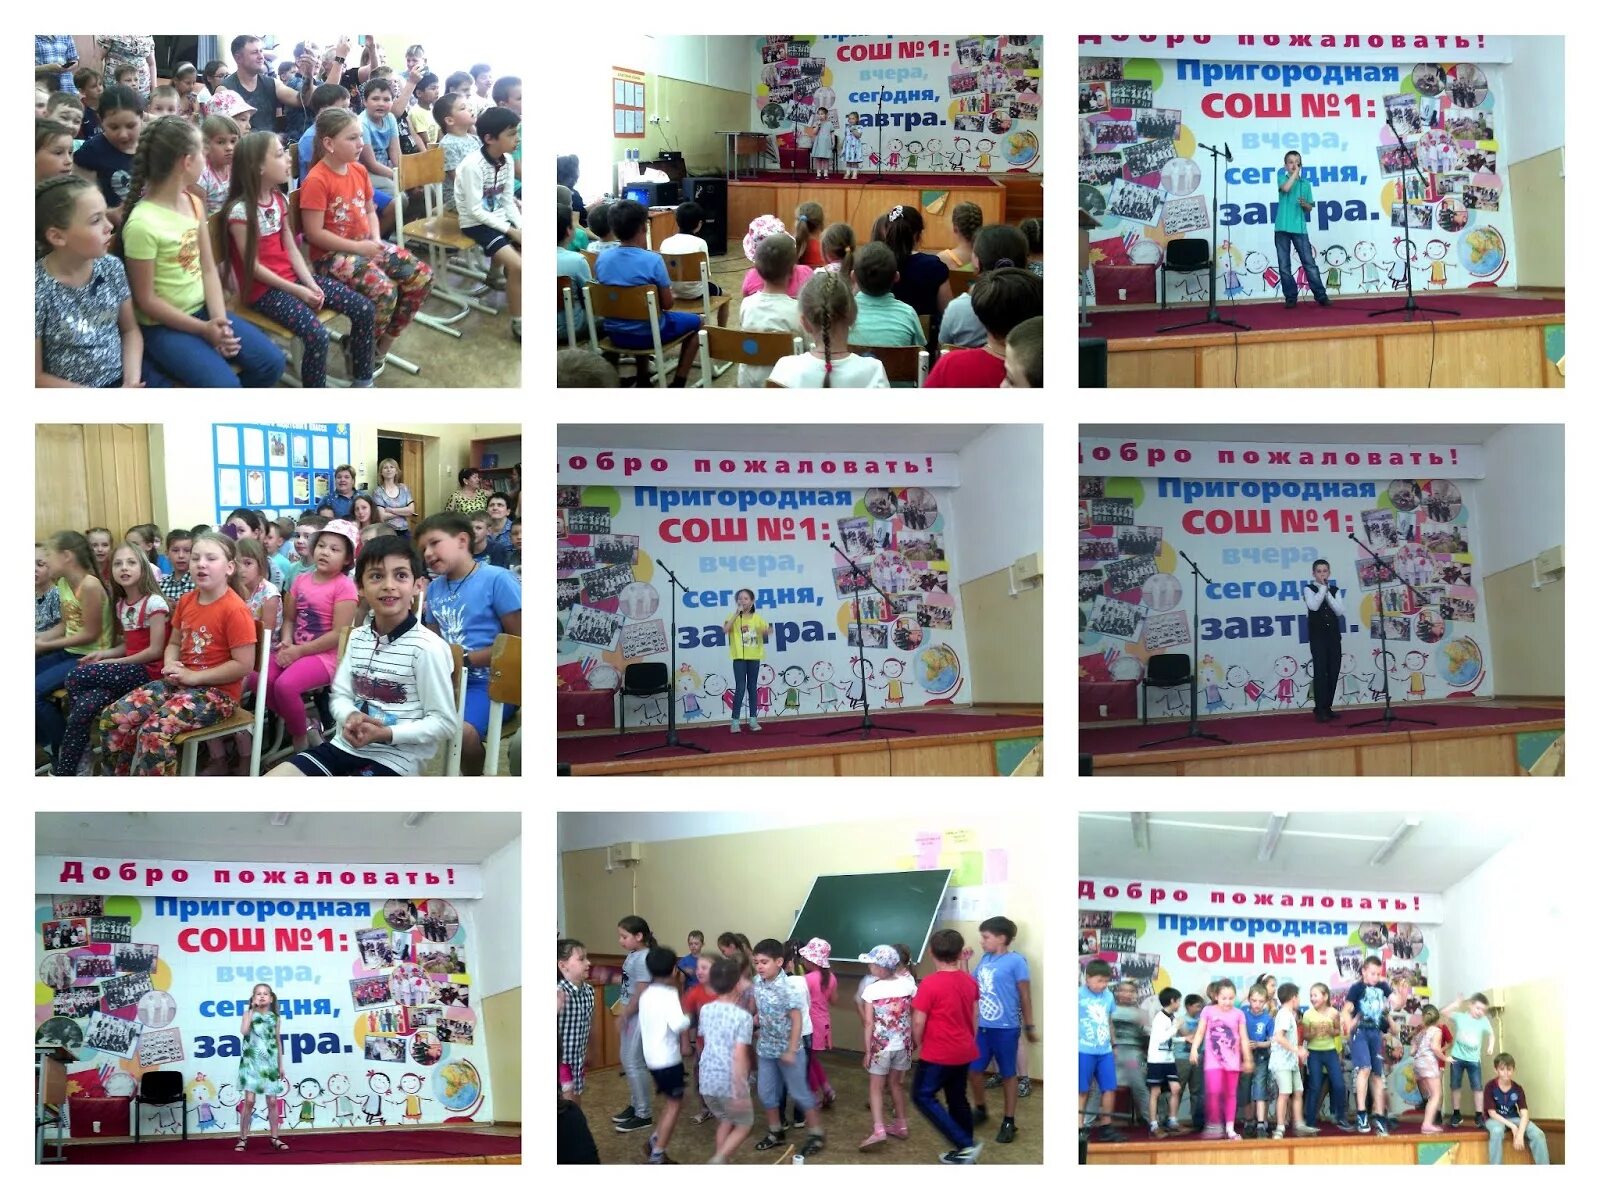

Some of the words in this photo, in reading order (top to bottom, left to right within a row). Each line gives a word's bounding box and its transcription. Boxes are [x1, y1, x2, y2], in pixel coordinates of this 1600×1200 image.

[836, 42, 892, 62] СОШ
[898, 40, 949, 59] №1:
[859, 67, 928, 83] вчера,
[1176, 58, 1400, 88] Пригородная
[848, 89, 940, 104] сегодня,
[1201, 92, 1291, 118] СОШ
[1301, 93, 1376, 118] №1:
[846, 111, 947, 131] автра.
[1241, 131, 1349, 155] вчера,
[1224, 165, 1368, 186] сегдня,
[1219, 200, 1380, 231] зара.
[557, 451, 668, 476] обро
[694, 457, 932, 474] пожаловать!
[1079, 442, 1191, 467] обро
[1218, 448, 1457, 465] пожаловать!
[633, 485, 853, 513] Пригородная
[1157, 476, 1376, 505] Пригородная
[658, 517, 748, 543] СОШ
[757, 517, 830, 541] №1:
[1182, 509, 1271, 535] СОШ
[1280, 509, 1354, 533] №1:
[699, 554, 804, 577] вчера,
[682, 587, 824, 609] сегдня,
[678, 620, 836, 651] зара.
[59, 861, 189, 887] Добро
[214, 868, 455, 885] пожаловать!
[1079, 880, 1188, 905] Добро
[1210, 892, 1420, 911] пожаловать!
[154, 895, 371, 923] Пригородная
[1157, 912, 1348, 938] Пригородная
[177, 927, 266, 952] СОШ
[274, 927, 348, 952] №1:
[1177, 941, 1255, 964] СОШ
[1263, 943, 1327, 965] №1:
[216, 965, 322, 988] вчера,
[199, 999, 341, 1020] сегдня,
